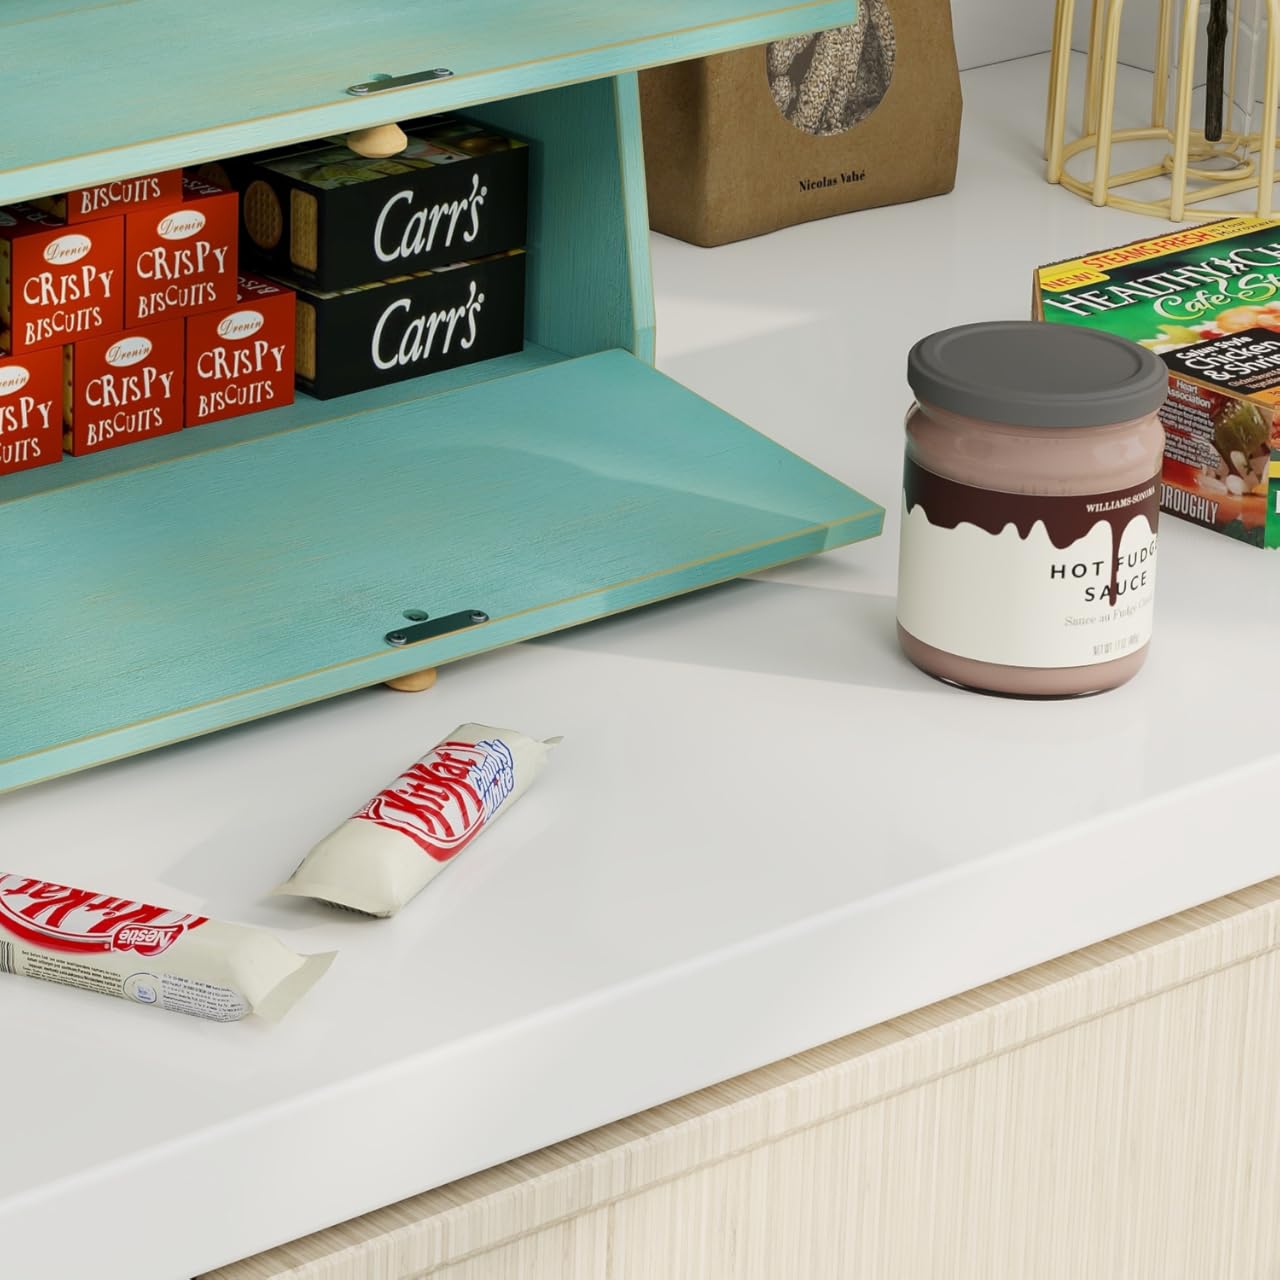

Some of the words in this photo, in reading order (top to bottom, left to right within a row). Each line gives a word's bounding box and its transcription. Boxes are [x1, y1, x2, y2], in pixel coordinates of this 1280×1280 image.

[80, 177, 161, 214] BISCUITS
[799, 176, 838, 192] Nicolas
[840, 170, 866, 184] Vahé
[373, 173, 488, 263] Carr's
[136, 240, 229, 281] CRISPY
[1082, 243, 1160, 270] STEAMS
[1154, 230, 1218, 256] FRESH
[23, 265, 115, 307] CRISPY
[137, 281, 217, 319] BISCUITS
[1040, 271, 1101, 291] NEW!
[1042, 260, 1233, 317] HEALTHY
[23, 306, 104, 346] BISCUITS
[371, 280, 485, 370] Carr's
[197, 340, 286, 381] CRISPY
[1176, 344, 1217, 360] Cajun
[1213, 336, 1254, 349] Style
[86, 367, 175, 409] CRISPY
[198, 380, 274, 418] BISCUITS
[1177, 379, 1198, 394] Heart
[86, 407, 163, 447] BISCUITS
[1086, 487, 1156, 513] WILLIAMS-SONOMA
[1050, 560, 1105, 579] HOT
[1084, 570, 1148, 602] SAUCE
